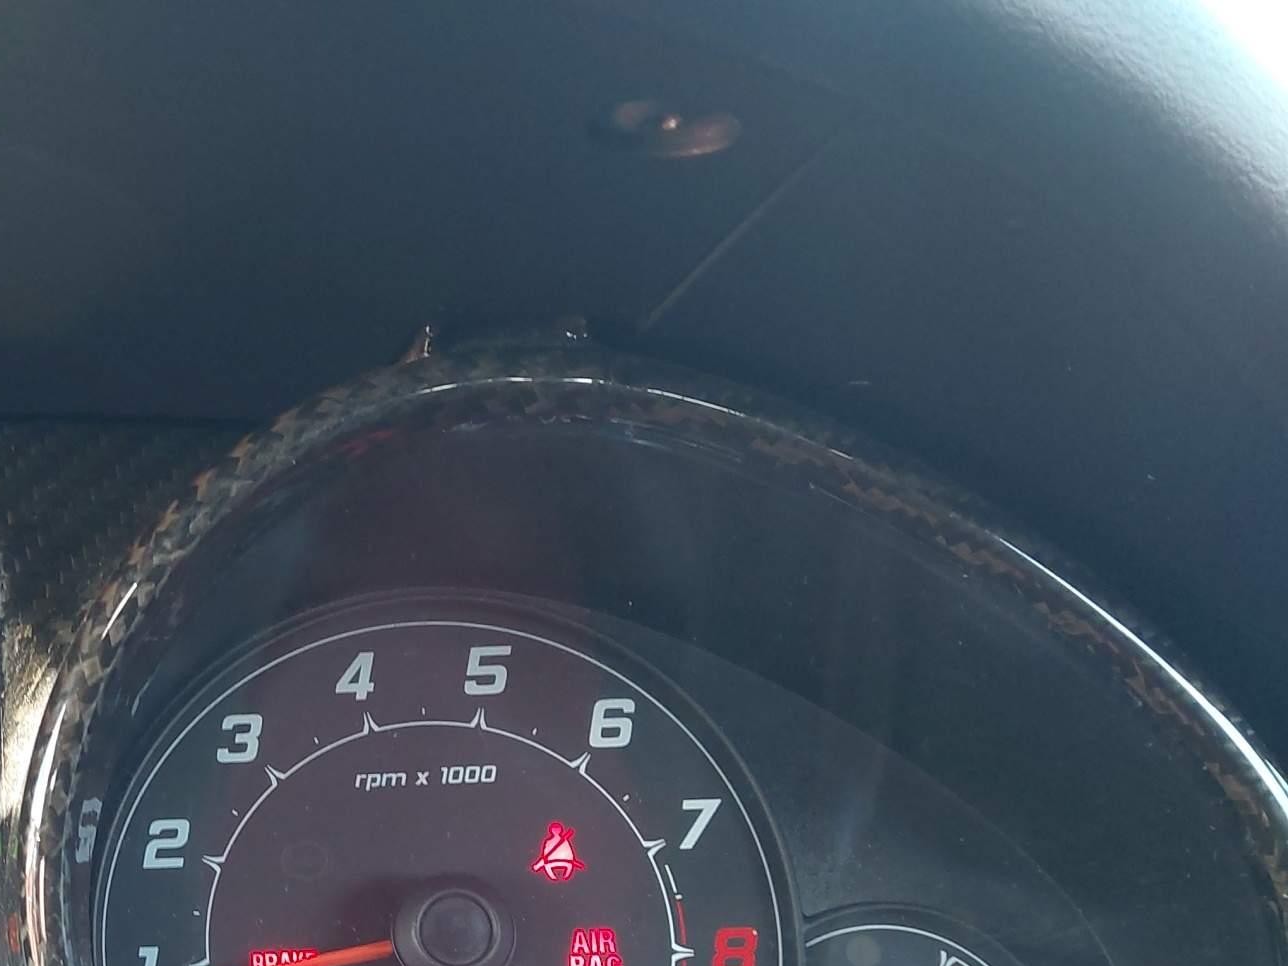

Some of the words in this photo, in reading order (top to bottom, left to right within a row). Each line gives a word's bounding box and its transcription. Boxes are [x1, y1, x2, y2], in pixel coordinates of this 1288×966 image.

[336, 651, 375, 700] 4
[464, 646, 512, 696] 5
[216, 714, 264, 763] 3
[588, 698, 636, 747] 6
[355, 770, 407, 790] rpm
[440, 764, 496, 786] 1000
[142, 818, 190, 869] 2
[681, 799, 722, 848] 7
[571, 928, 616, 954] AIR
